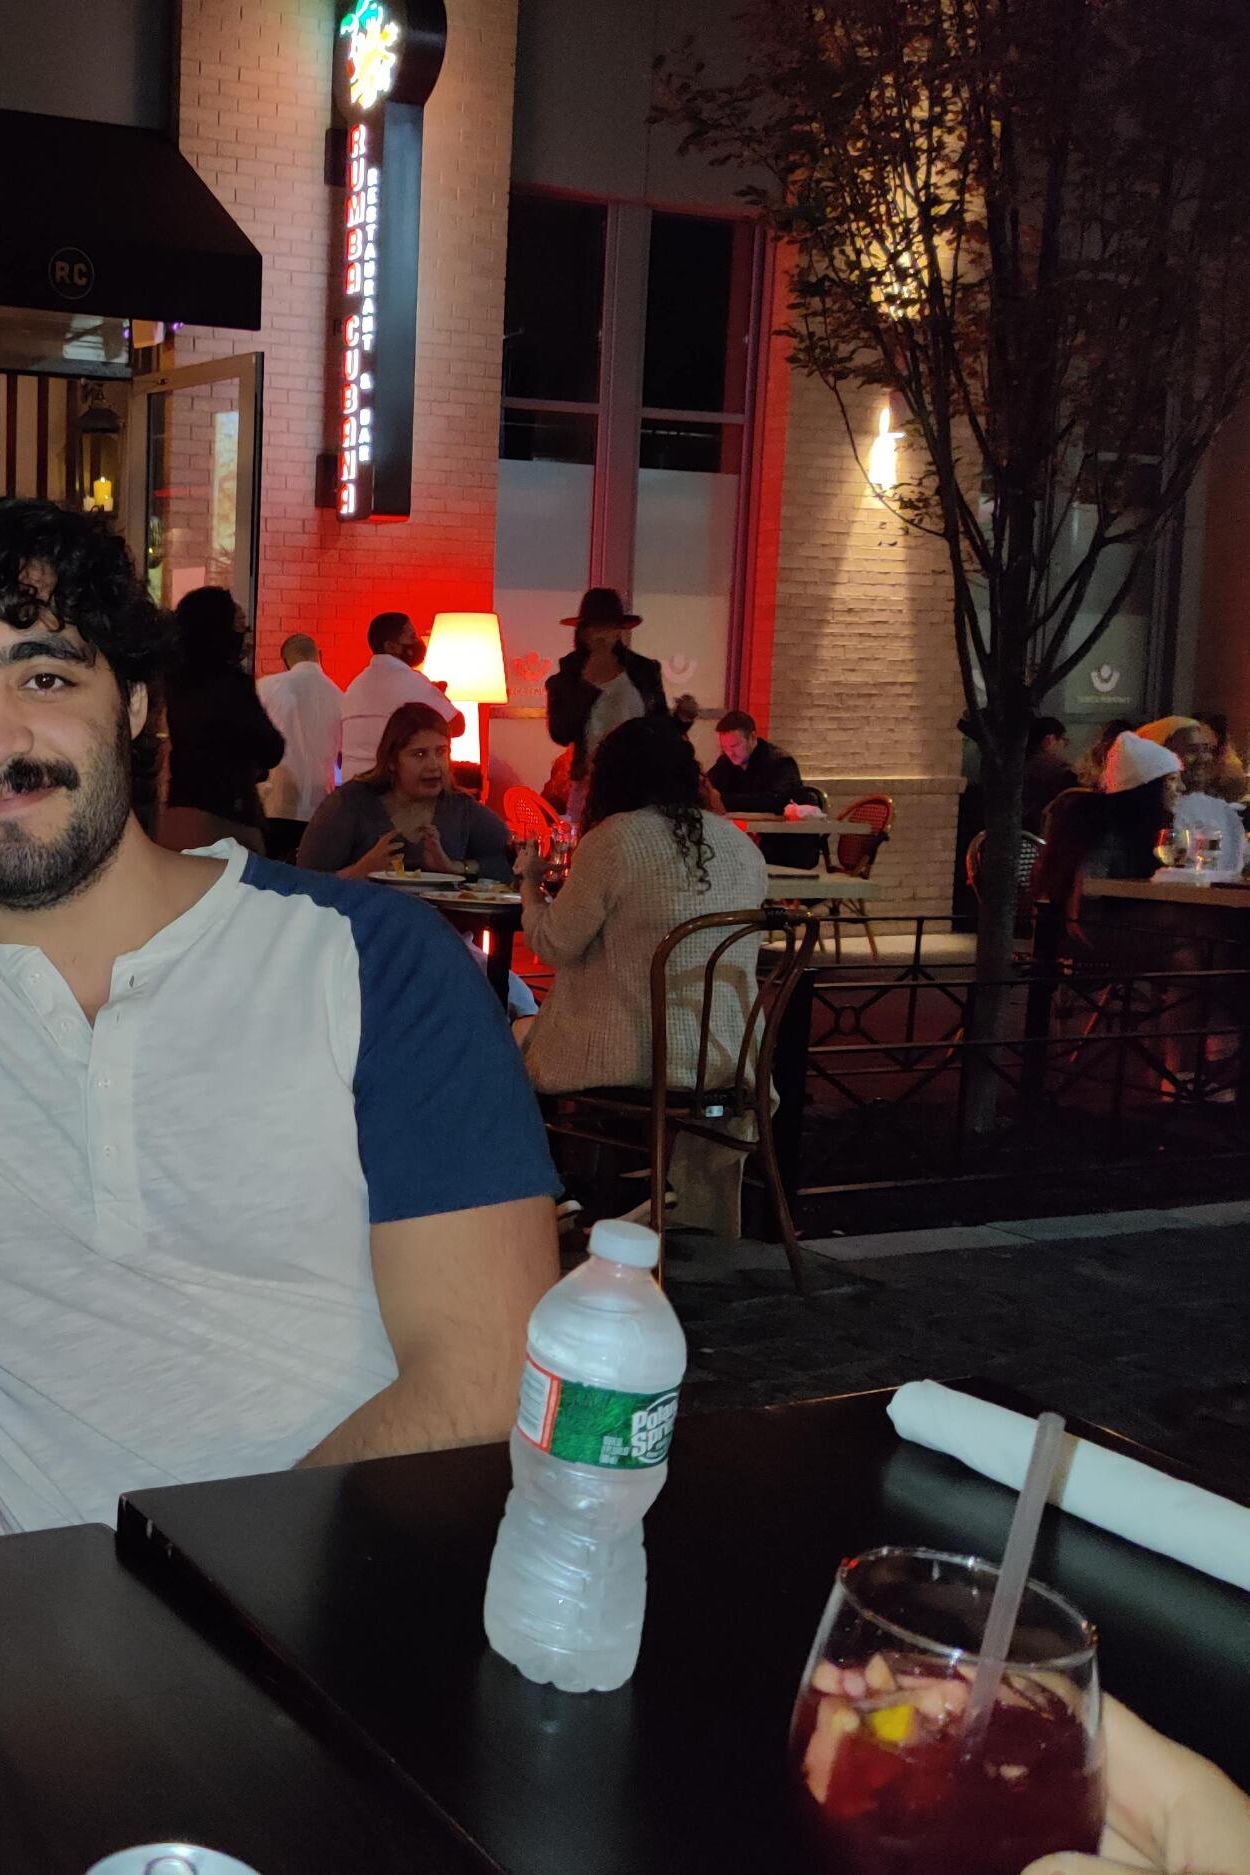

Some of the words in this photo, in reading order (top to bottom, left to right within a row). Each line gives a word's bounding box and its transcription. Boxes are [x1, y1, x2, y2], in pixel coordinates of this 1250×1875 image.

[55, 261, 88, 286] RC
[345, 123, 367, 294] RUMBA
[362, 167, 378, 350] RESTAURANT
[338, 315, 360, 514] CUBANA
